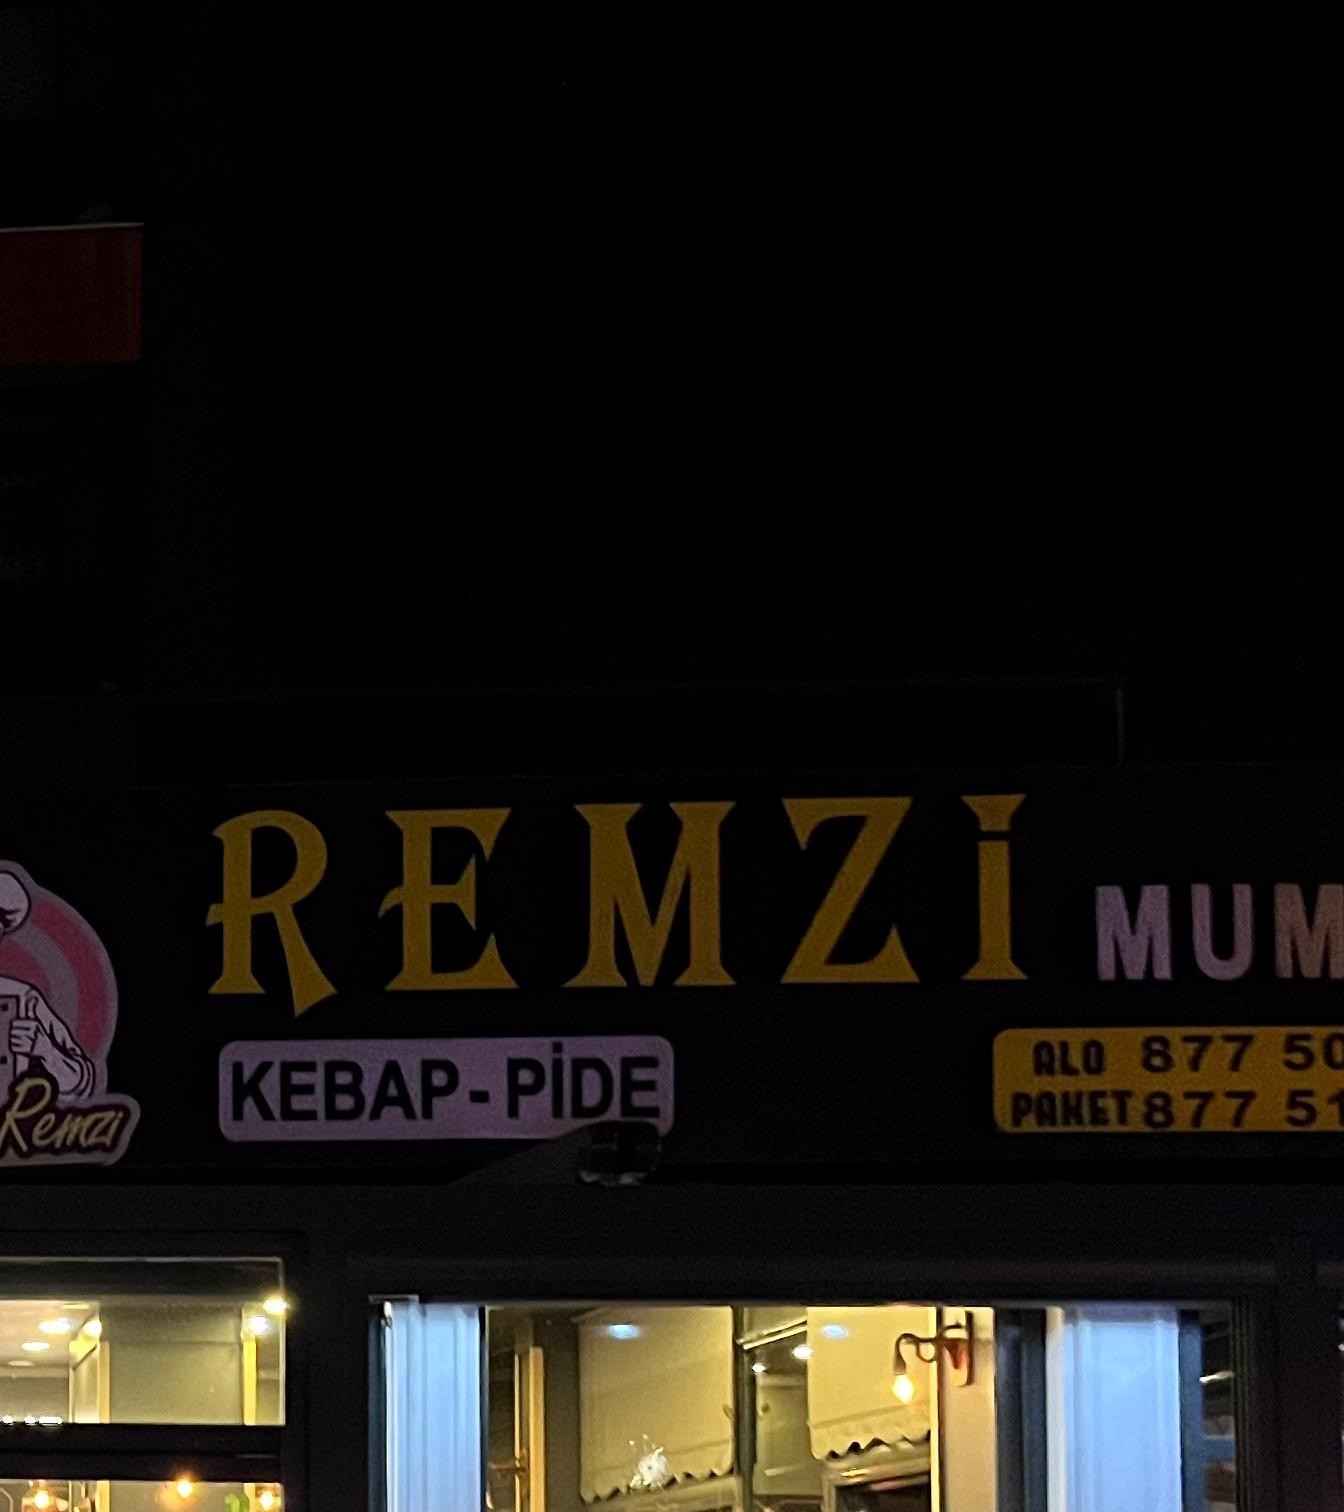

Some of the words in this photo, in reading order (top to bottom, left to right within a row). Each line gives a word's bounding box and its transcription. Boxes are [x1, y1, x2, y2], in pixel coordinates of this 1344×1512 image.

[204, 794, 1028, 1017] REMZİ
[1141, 1034, 1256, 1073] 877
[1143, 1089, 1257, 1129] 877
